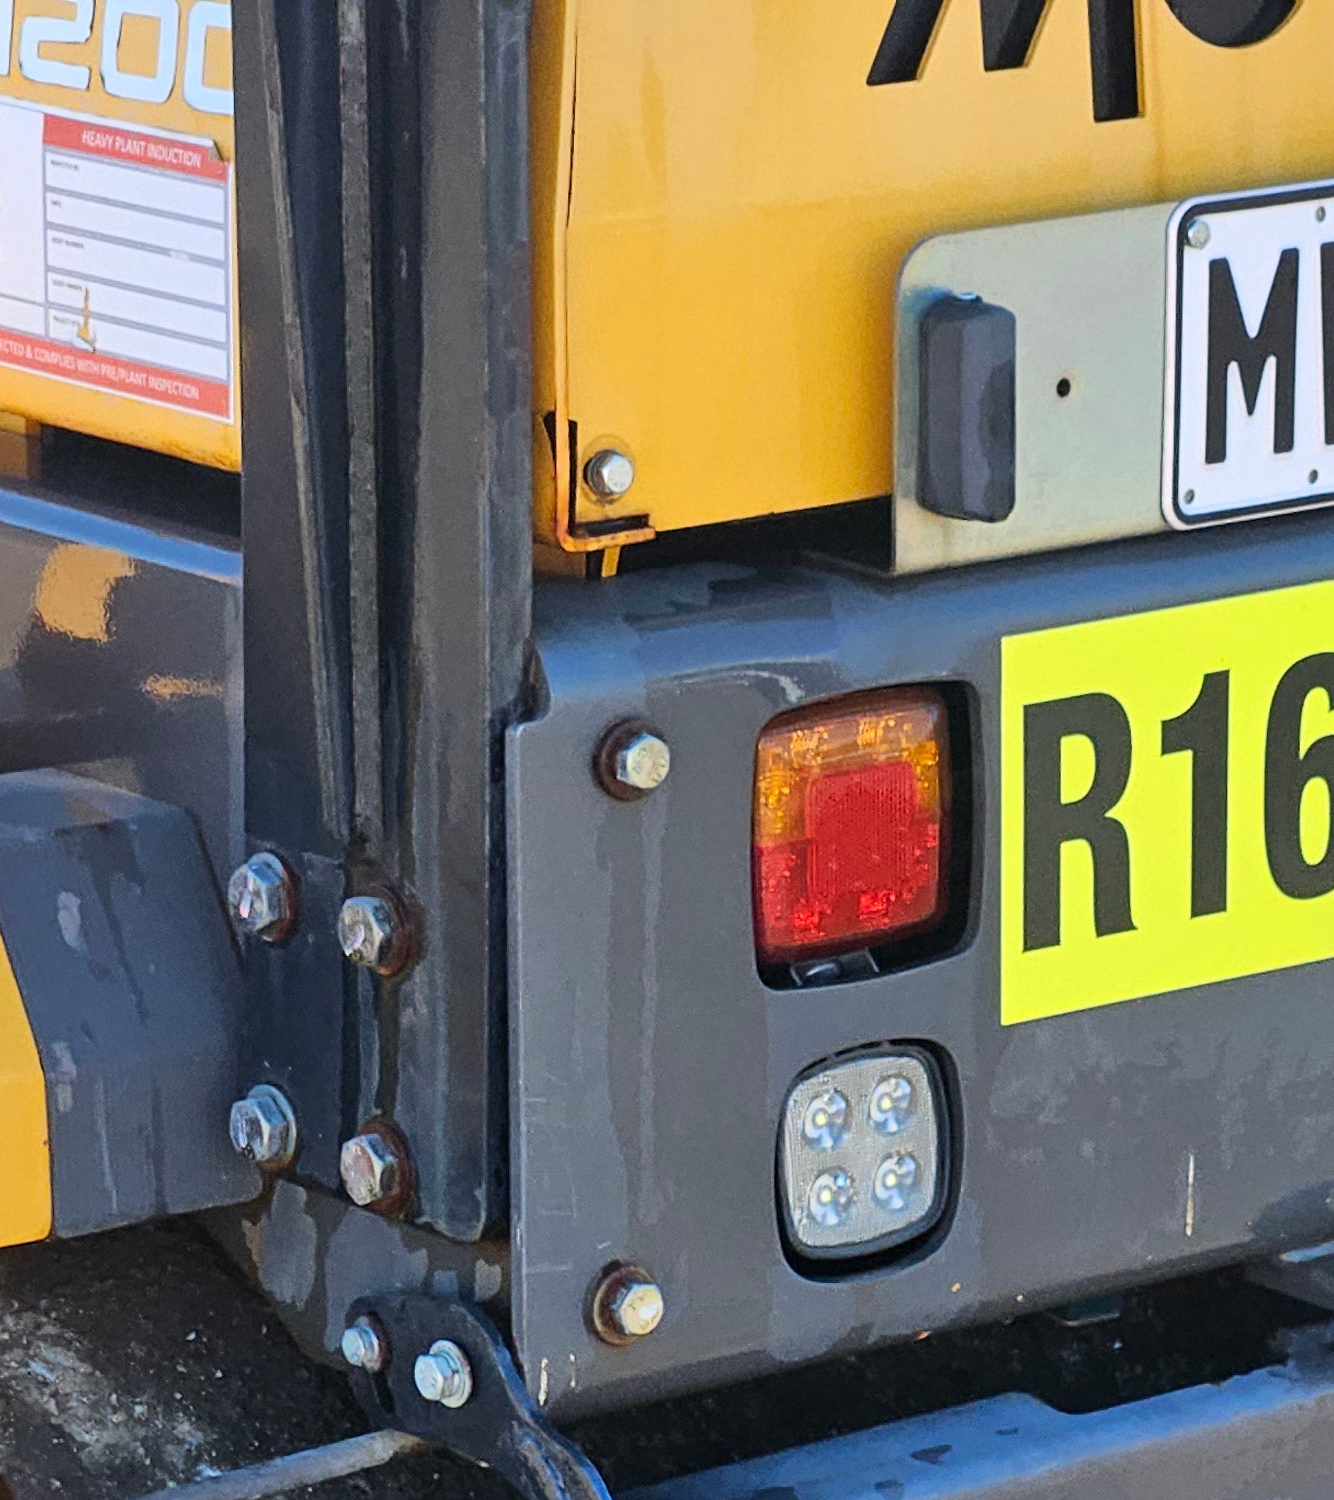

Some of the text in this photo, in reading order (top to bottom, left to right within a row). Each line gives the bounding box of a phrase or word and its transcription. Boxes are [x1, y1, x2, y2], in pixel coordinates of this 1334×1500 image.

[81, 130, 201, 168] HEAVY PLANT INDUCTION
[34, 347, 76, 370] COMPLIES
[148, 376, 200, 399] INSPECTION
